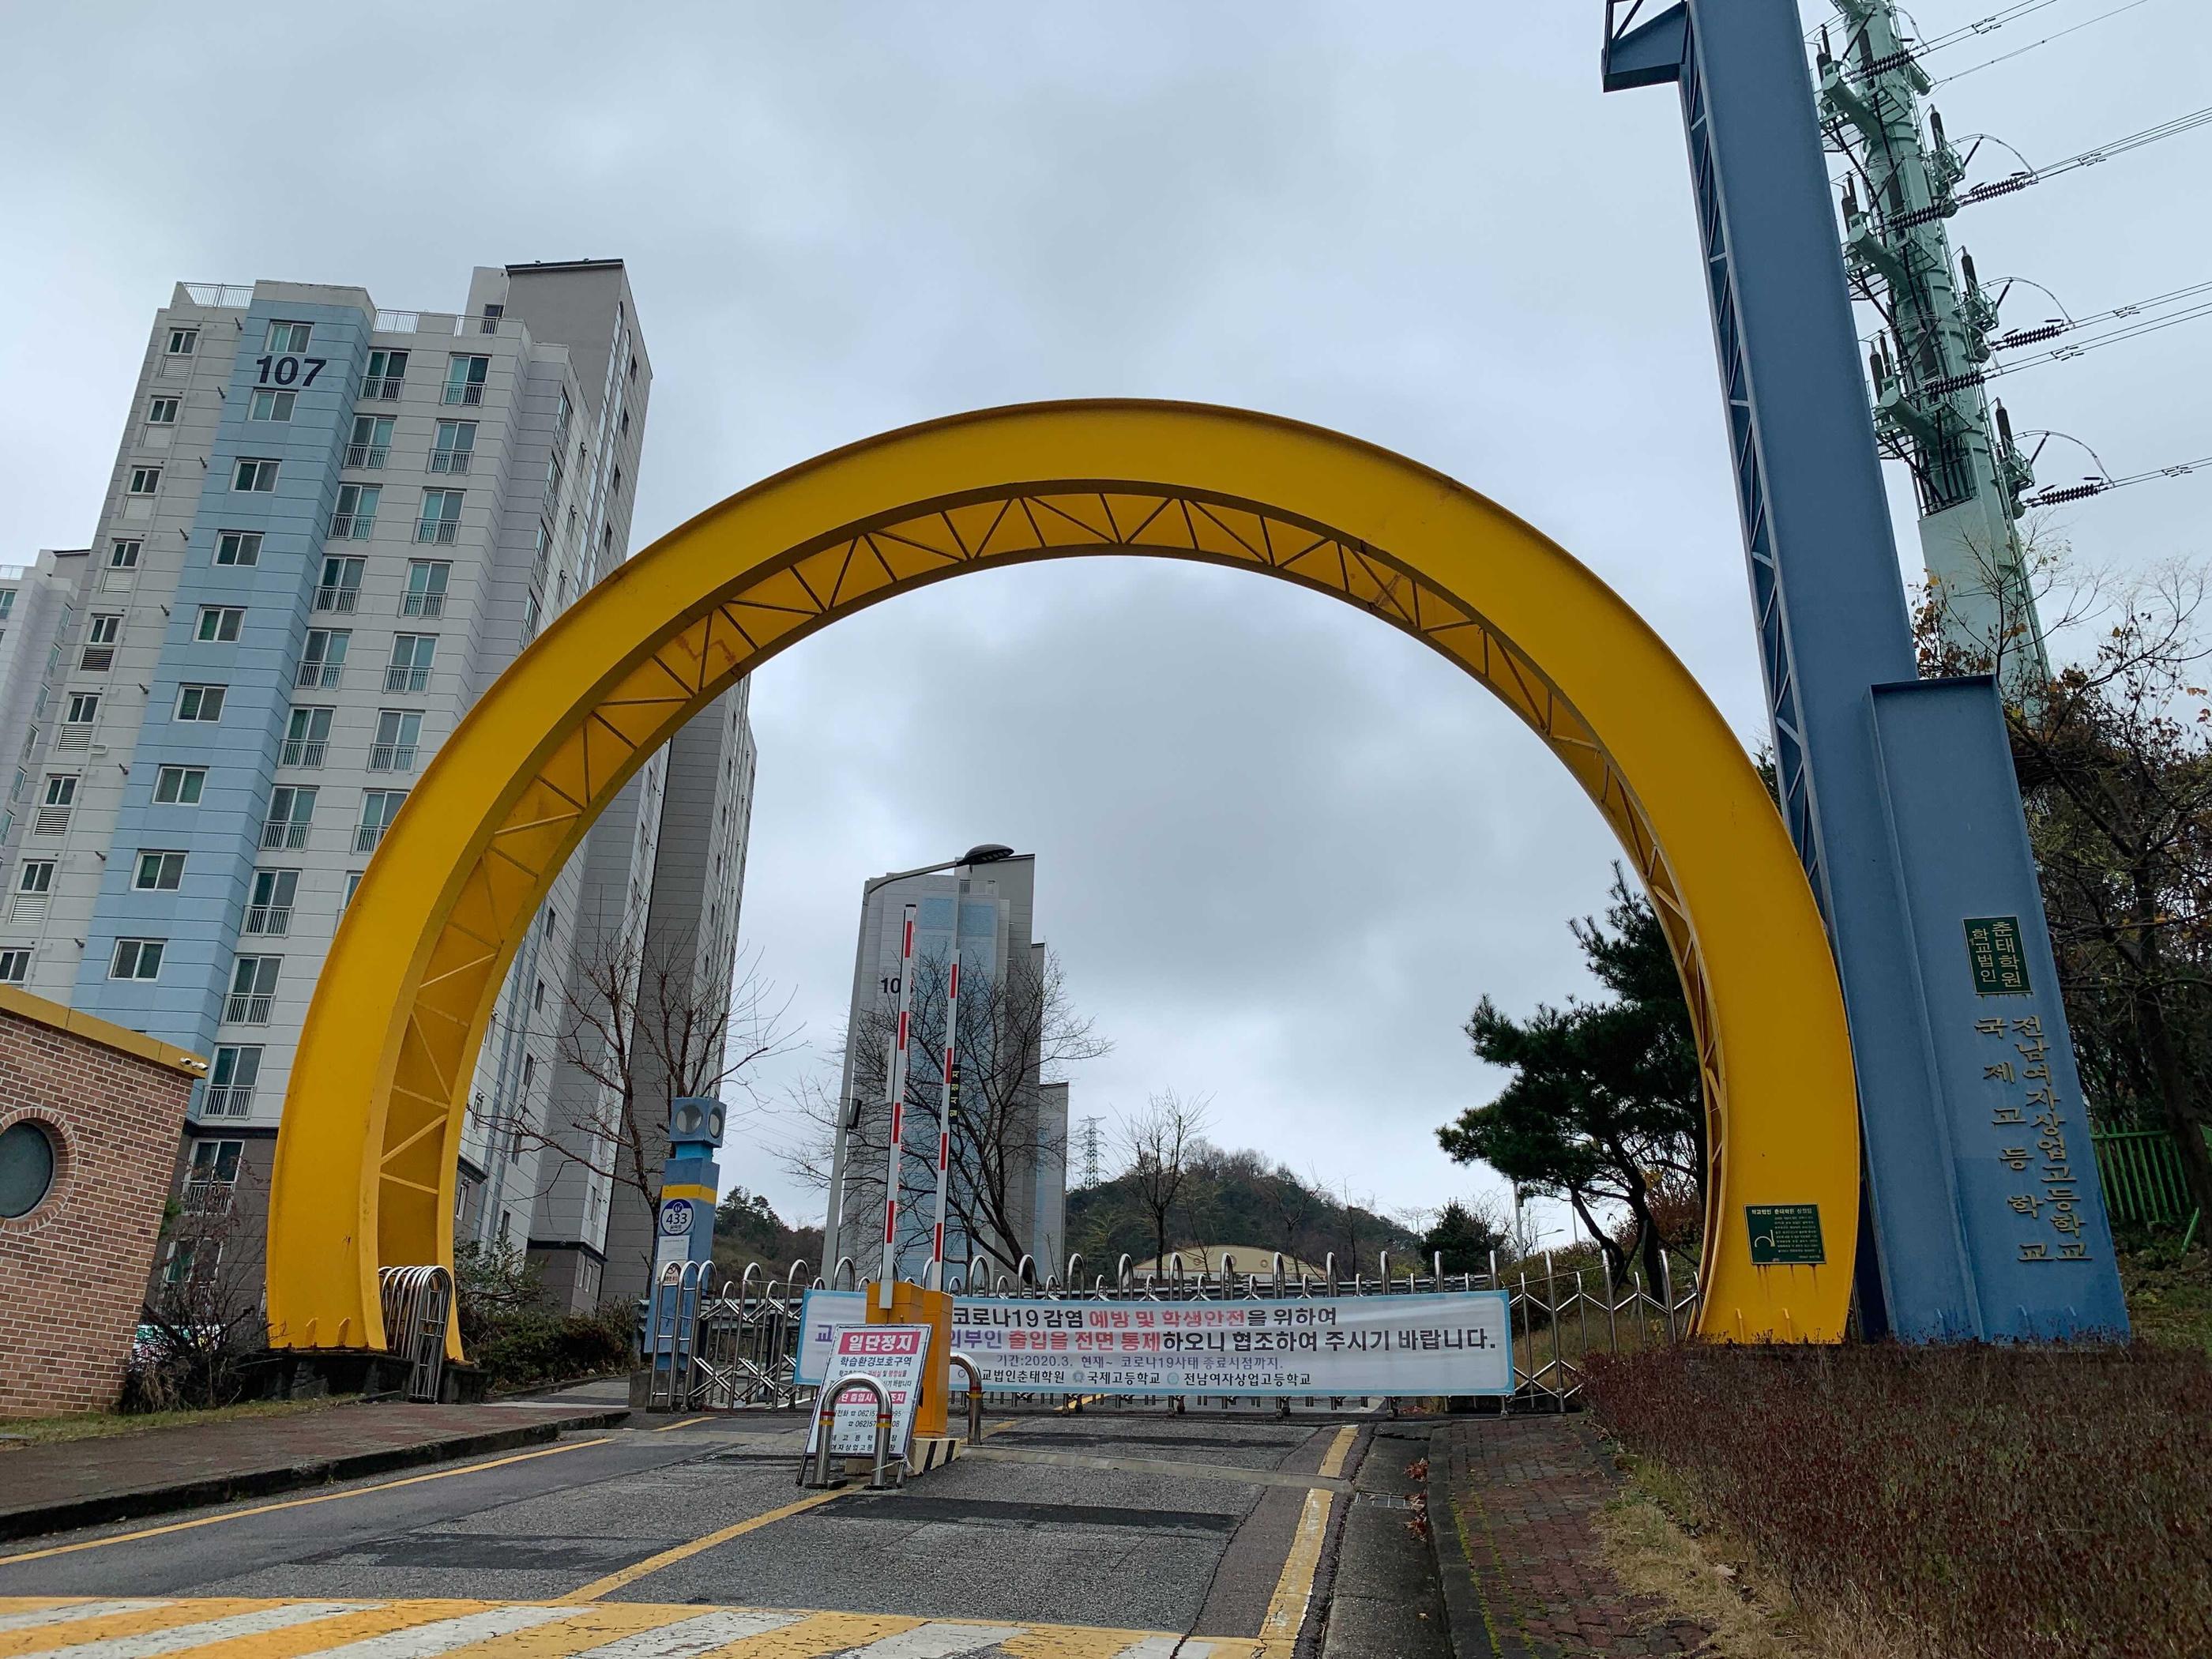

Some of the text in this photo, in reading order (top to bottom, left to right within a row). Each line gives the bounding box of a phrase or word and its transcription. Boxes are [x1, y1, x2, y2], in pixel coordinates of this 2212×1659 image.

[256, 356, 327, 387] 107
[1972, 928, 1997, 983] 학교법인
[1992, 921, 2022, 988] 춘태학원
[881, 977, 914, 994] 10
[949, 1070, 960, 1117] 일시정지
[1974, 1018, 2055, 1262] 국제고등학교
[2012, 1014, 2093, 1261] 전남여자상업고등학교
[665, 1213, 688, 1224] 433
[953, 1307, 1337, 1328] 코로나19 감염 예방 및 학생안전을 위하여
[848, 1334, 912, 1352] 일단정지
[1009, 1330, 1068, 1350] 출입을
[1075, 1331, 1113, 1351] 전면
[1121, 1331, 1224, 1352] 통제하오니
[1232, 1331, 1317, 1352] 협조하여
[1325, 1330, 1390, 1351] 주시기
[1398, 1328, 1495, 1350] 바랍니다.
[840, 1356, 912, 1367] 학습환경보호구역
[1121, 1356, 1198, 1369] 코로나19사태
[1203, 1356, 1283, 1370] 종료시점까지.
[981, 1369, 1311, 1386] 교법인춘태학원 국제고등학교 전남여자상업고등학교
